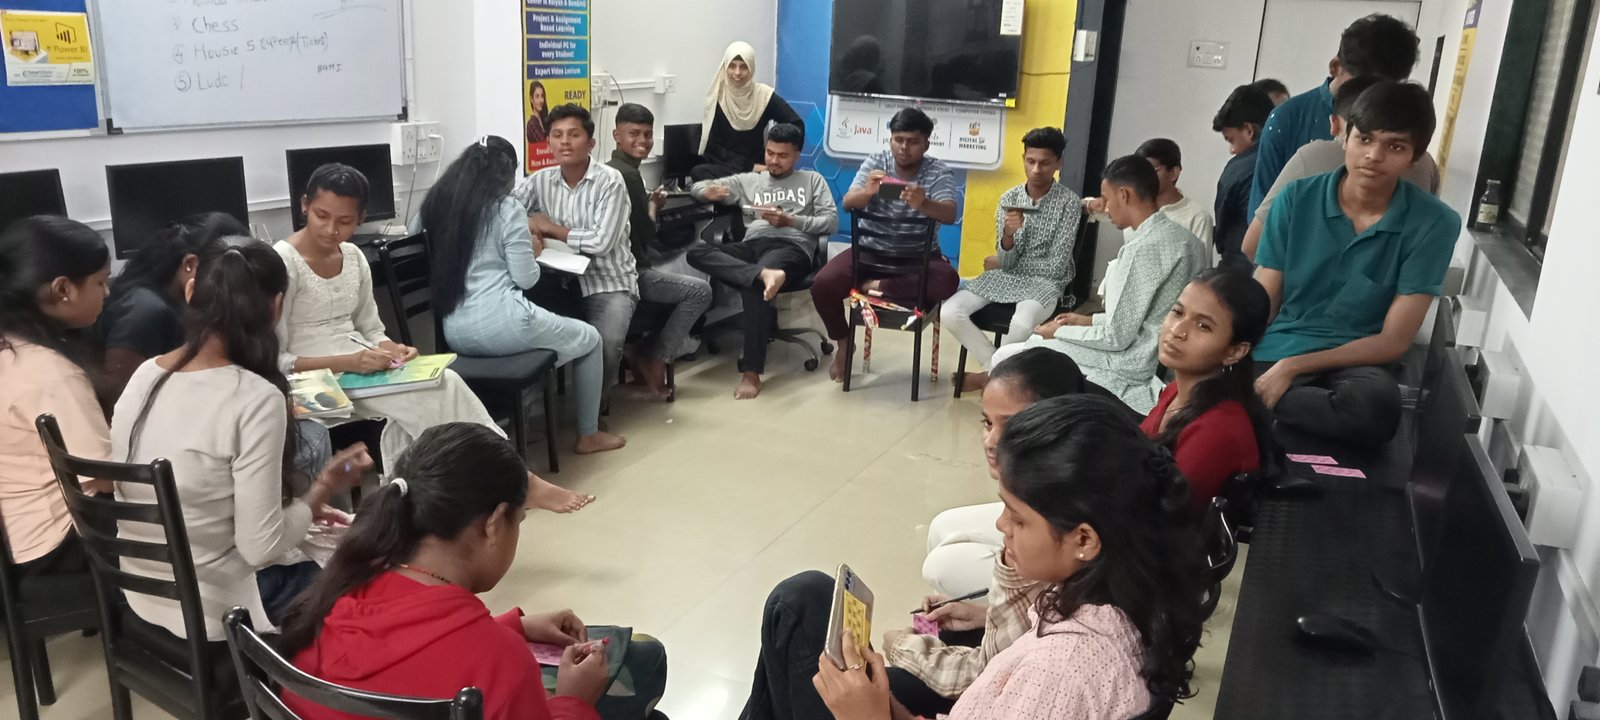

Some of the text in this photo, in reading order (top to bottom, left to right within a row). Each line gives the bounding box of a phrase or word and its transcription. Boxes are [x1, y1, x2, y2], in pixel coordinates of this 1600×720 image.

[532, 13, 550, 22] Project
[192, 16, 239, 34] Chess
[538, 40, 563, 49] Individual
[562, 41, 570, 49] PC
[53, 45, 78, 54] Power
[555, 50, 575, 58] Student
[534, 67, 551, 77] Expert
[550, 66, 564, 75] Video
[565, 91, 586, 99] READY
[854, 124, 872, 135] Java
[753, 187, 806, 207] ADIDAS
